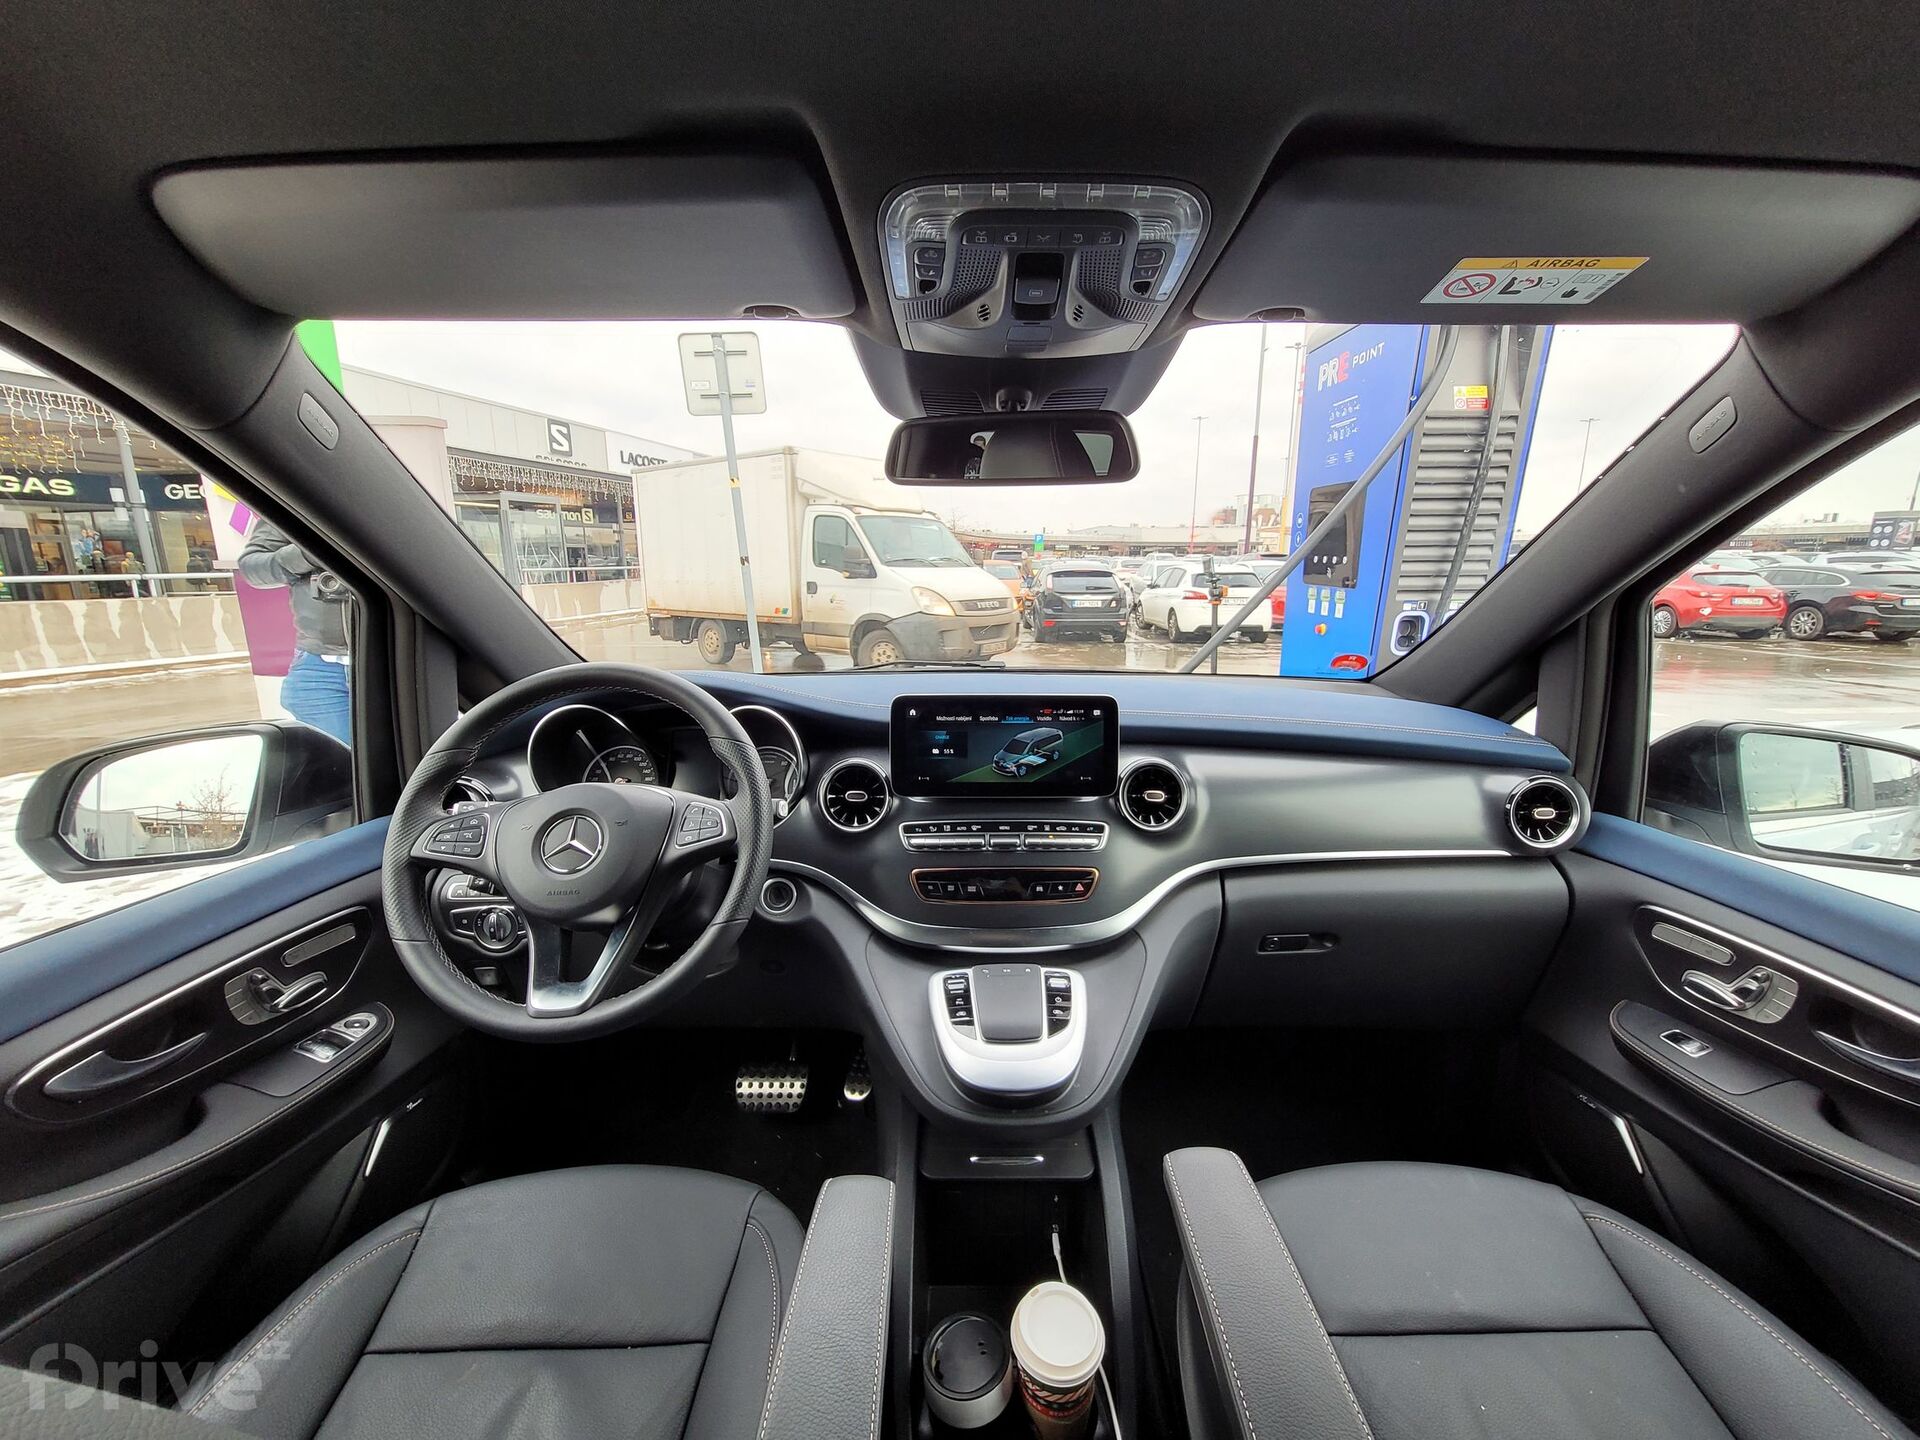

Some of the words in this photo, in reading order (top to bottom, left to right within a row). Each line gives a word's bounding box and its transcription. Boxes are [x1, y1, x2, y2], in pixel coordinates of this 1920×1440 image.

[1527, 259, 1600, 268] AIRBAG
[1318, 351, 1350, 392] PRE
[1352, 342, 1385, 368] POINT
[0, 475, 75, 496] GAS
[976, 601, 1000, 609] IVECO
[546, 889, 581, 897] AIRBAG
